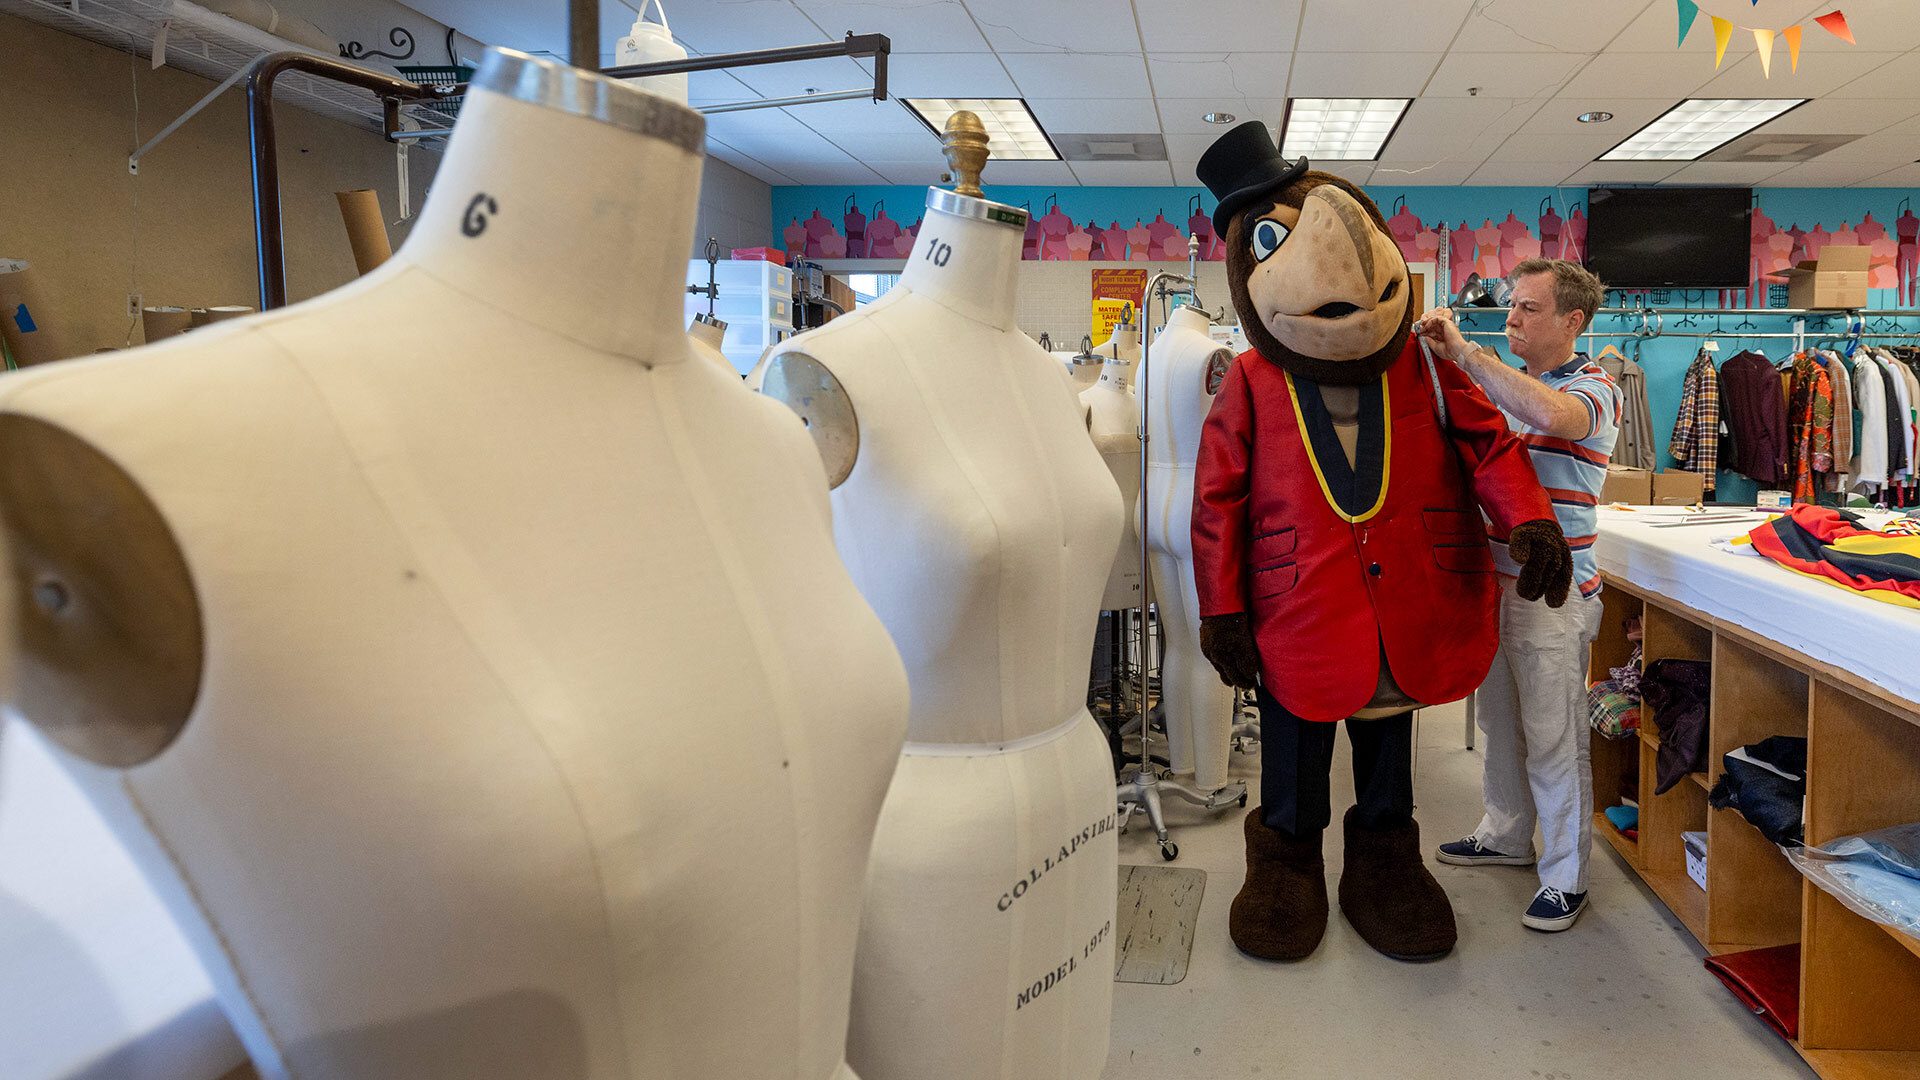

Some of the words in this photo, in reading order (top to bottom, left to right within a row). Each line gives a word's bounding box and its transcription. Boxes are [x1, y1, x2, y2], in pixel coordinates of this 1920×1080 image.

[926, 237, 951, 267] 10
[1100, 286, 1139, 294] COMPLIANCE
[1132, 583, 1140, 591] 10
[1016, 956, 1077, 1011] MODEL
[1083, 920, 1110, 959] 1979
